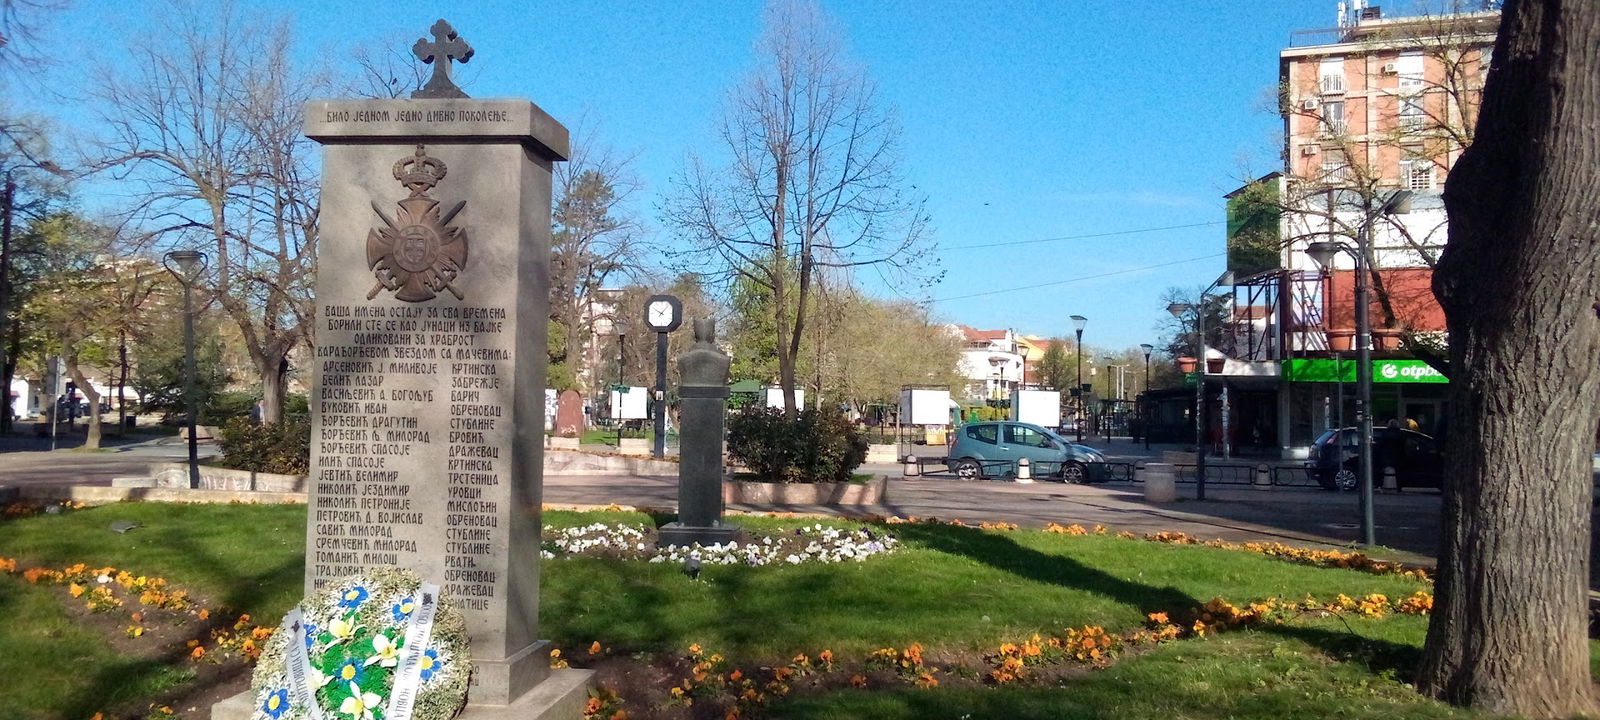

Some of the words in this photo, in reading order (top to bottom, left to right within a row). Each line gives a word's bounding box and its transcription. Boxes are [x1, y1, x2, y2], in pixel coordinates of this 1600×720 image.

[353, 111, 390, 122] ЈЕДНОМ
[394, 111, 422, 122] ЈЕДНО
[427, 111, 455, 122] ДИВНО
[325, 306, 350, 317] ВАША
[355, 307, 385, 317] ИМЕНА
[390, 307, 423, 318] ОСТАЈУ
[428, 307, 438, 318] ЗА
[443, 307, 458, 318] СВА
[464, 307, 506, 319] ВРЕМЕНА
[329, 320, 362, 331] БОРИЛИ
[367, 320, 381, 331] СТЕ
[386, 320, 396, 331] СЕ
[400, 321, 417, 332] КАО
[421, 321, 456, 333] ЈУНАЦИ
[459, 321, 470, 332] ИЗ
[474, 321, 502, 333] БАЈКЕ
[354, 334, 411, 345] ОДЛИКОВАНИ
[415, 334, 426, 345] ЗА
[430, 335, 474, 346] ХРАБРОСТ
[394, 347, 436, 359] ЗВЕЗДОМ
[441, 348, 451, 358] СА
[323, 362, 374, 373] АРСЕНОВИЋ
[389, 363, 437, 374] МИЛИВОЈЕ
[452, 364, 496, 375] КРТИНСКА
[355, 376, 383, 387] ЛАЗАР
[452, 377, 500, 389] ЗАБРЕЖЈЕ
[322, 389, 375, 400] ВАСИЉЕВИЋ
[392, 390, 433, 402] БОГОЉУБ
[321, 402, 360, 413] ВУКОВИЋ
[364, 403, 387, 414] ИВАН
[451, 404, 501, 417] ОБРЕНОВАЦ
[372, 417, 417, 428] ДРАГУТИН
[451, 418, 494, 430] СТУБЛИНЕ
[387, 430, 430, 443] МИЛОРАД
[450, 432, 484, 444] БРОВИЋ
[372, 444, 410, 455] СПАСОЈЕ
[449, 446, 498, 458] ДРАЖЕВАЦ
[318, 456, 343, 467] ИЛИЋ
[346, 457, 384, 468] СПАСОЈЕ
[448, 460, 493, 471] КРТИНСКА
[318, 470, 352, 481] ЈЕВТИЋ
[356, 471, 398, 482] ВЕЛИМИР
[448, 473, 498, 485] ТРСТЕНИЦА
[318, 484, 358, 495] НИКОЛИЋ
[362, 485, 409, 496] ЈЕЗДИМИР
[448, 487, 482, 499] УРОВЦИ
[317, 498, 357, 508] НИКОЛИЋ
[361, 498, 410, 510] ПЕТРОНИЈЕ
[317, 511, 362, 523] ПЕТРОВИЋ
[378, 513, 423, 525] ВОЈИСЛАВ
[447, 515, 497, 527] ОБРЕНОВАЦ
[317, 524, 346, 536] САВИЋ
[350, 525, 392, 538] МИЛОРАД
[446, 529, 490, 541] СТУБЛИНЕ
[316, 538, 369, 551] СРЕМЧЕВИЋ
[374, 540, 417, 552] МИЛОРАД
[446, 542, 490, 554] СТУБЛИНЕ
[316, 552, 359, 563] ТОМАНИЋ
[363, 553, 397, 565] МИЛОШ
[444, 571, 496, 583] ОБРЕНОВАЦ
